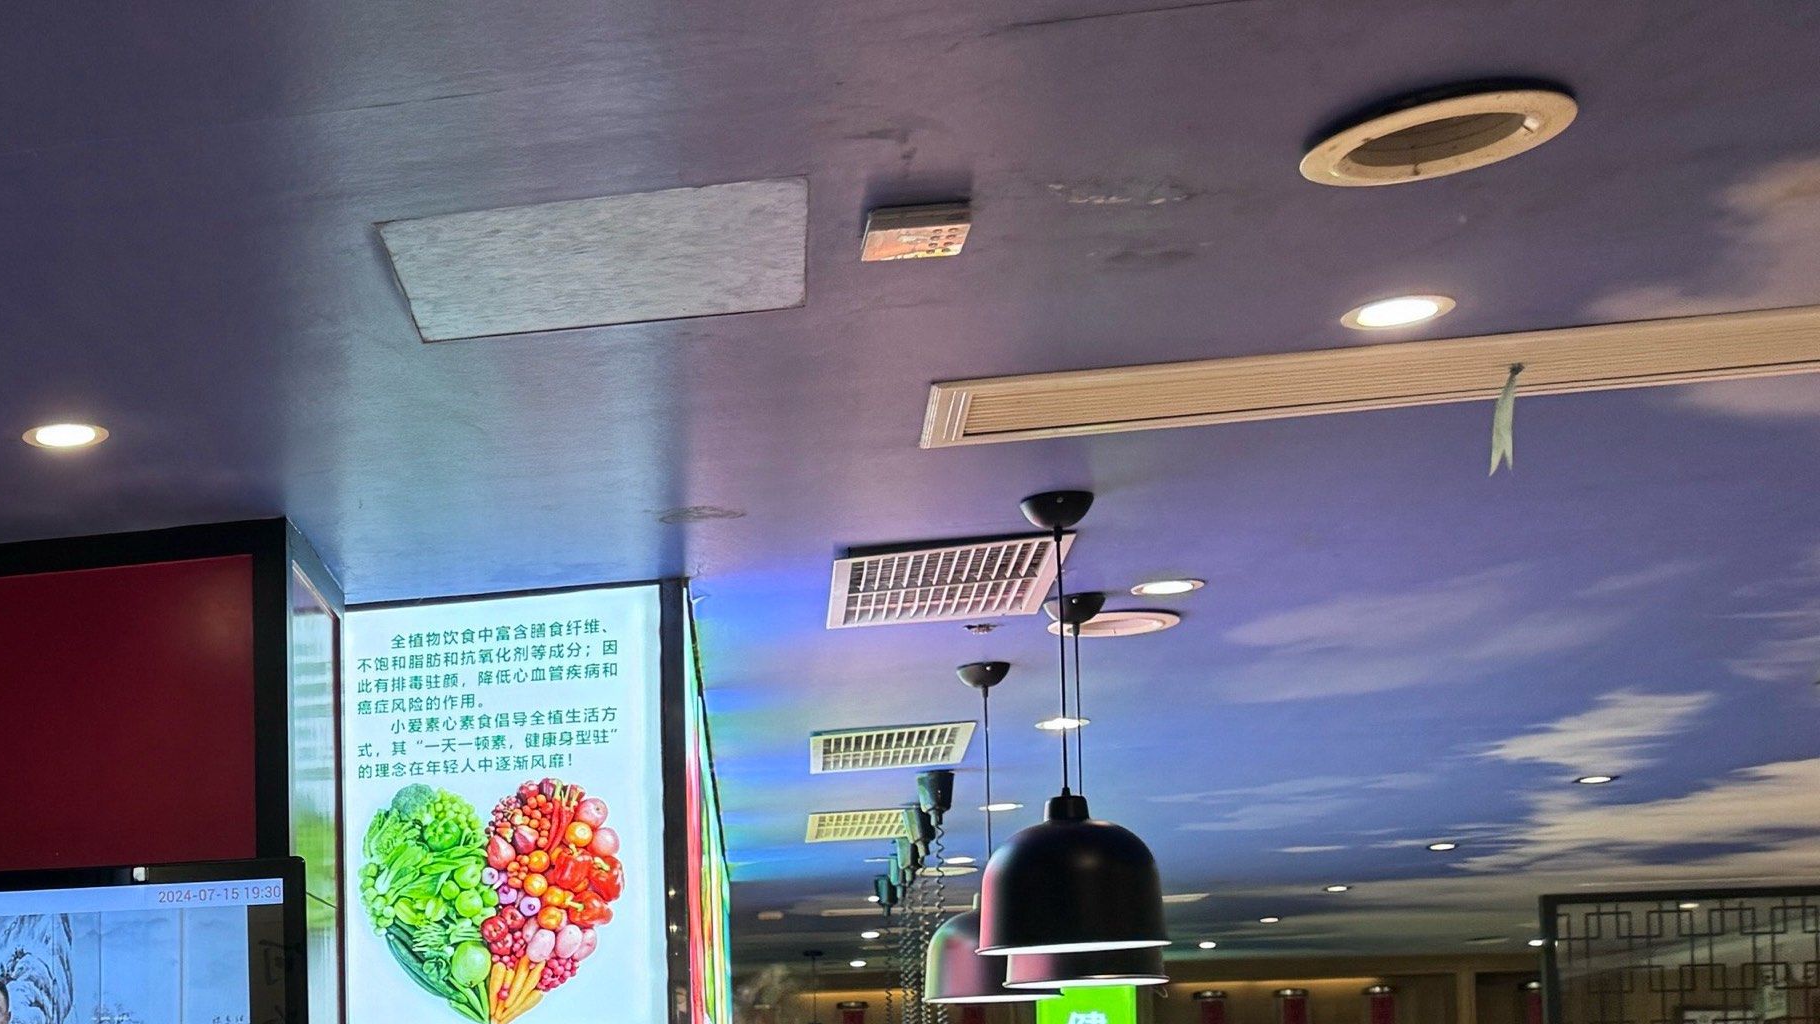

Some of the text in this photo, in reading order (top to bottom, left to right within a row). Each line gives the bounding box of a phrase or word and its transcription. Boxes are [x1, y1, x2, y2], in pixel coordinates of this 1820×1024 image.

[390, 617, 610, 650] 全植物饮食中富含膳食纤维、
[357, 662, 618, 694] 此有排毒驻颜，降低心血管疾病和
[357, 693, 484, 715] 癌症风险的作用。
[390, 707, 618, 734] 小爱素心素食倡导全植生活方
[158, 885, 281, 903] 2024-07-15 19:30
